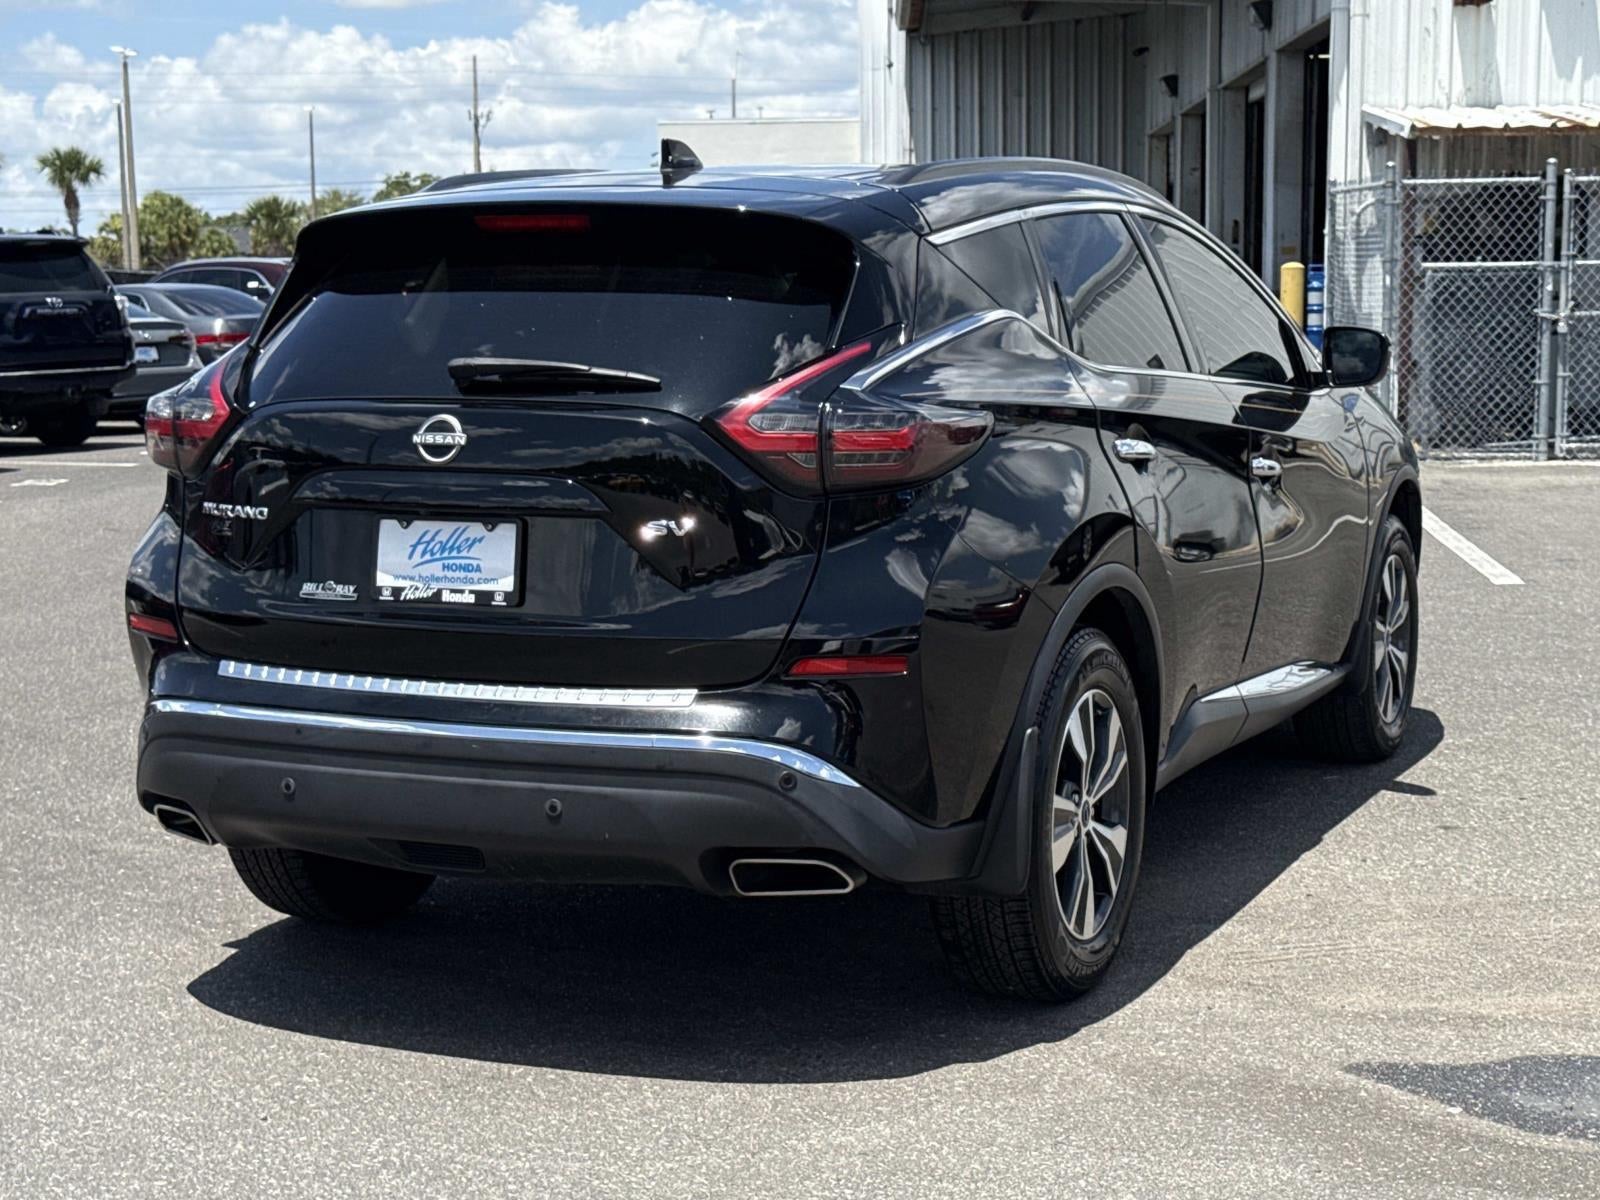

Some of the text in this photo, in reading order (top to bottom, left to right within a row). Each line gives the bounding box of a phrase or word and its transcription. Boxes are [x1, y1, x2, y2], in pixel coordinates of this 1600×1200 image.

[412, 433, 467, 446] NISSAN
[640, 517, 696, 541] SV
[408, 525, 486, 561] Holler
[442, 562, 482, 574] HONDA
[393, 573, 500, 586] www.hollerhonda.com
[400, 583, 476, 604] Holler Honda
